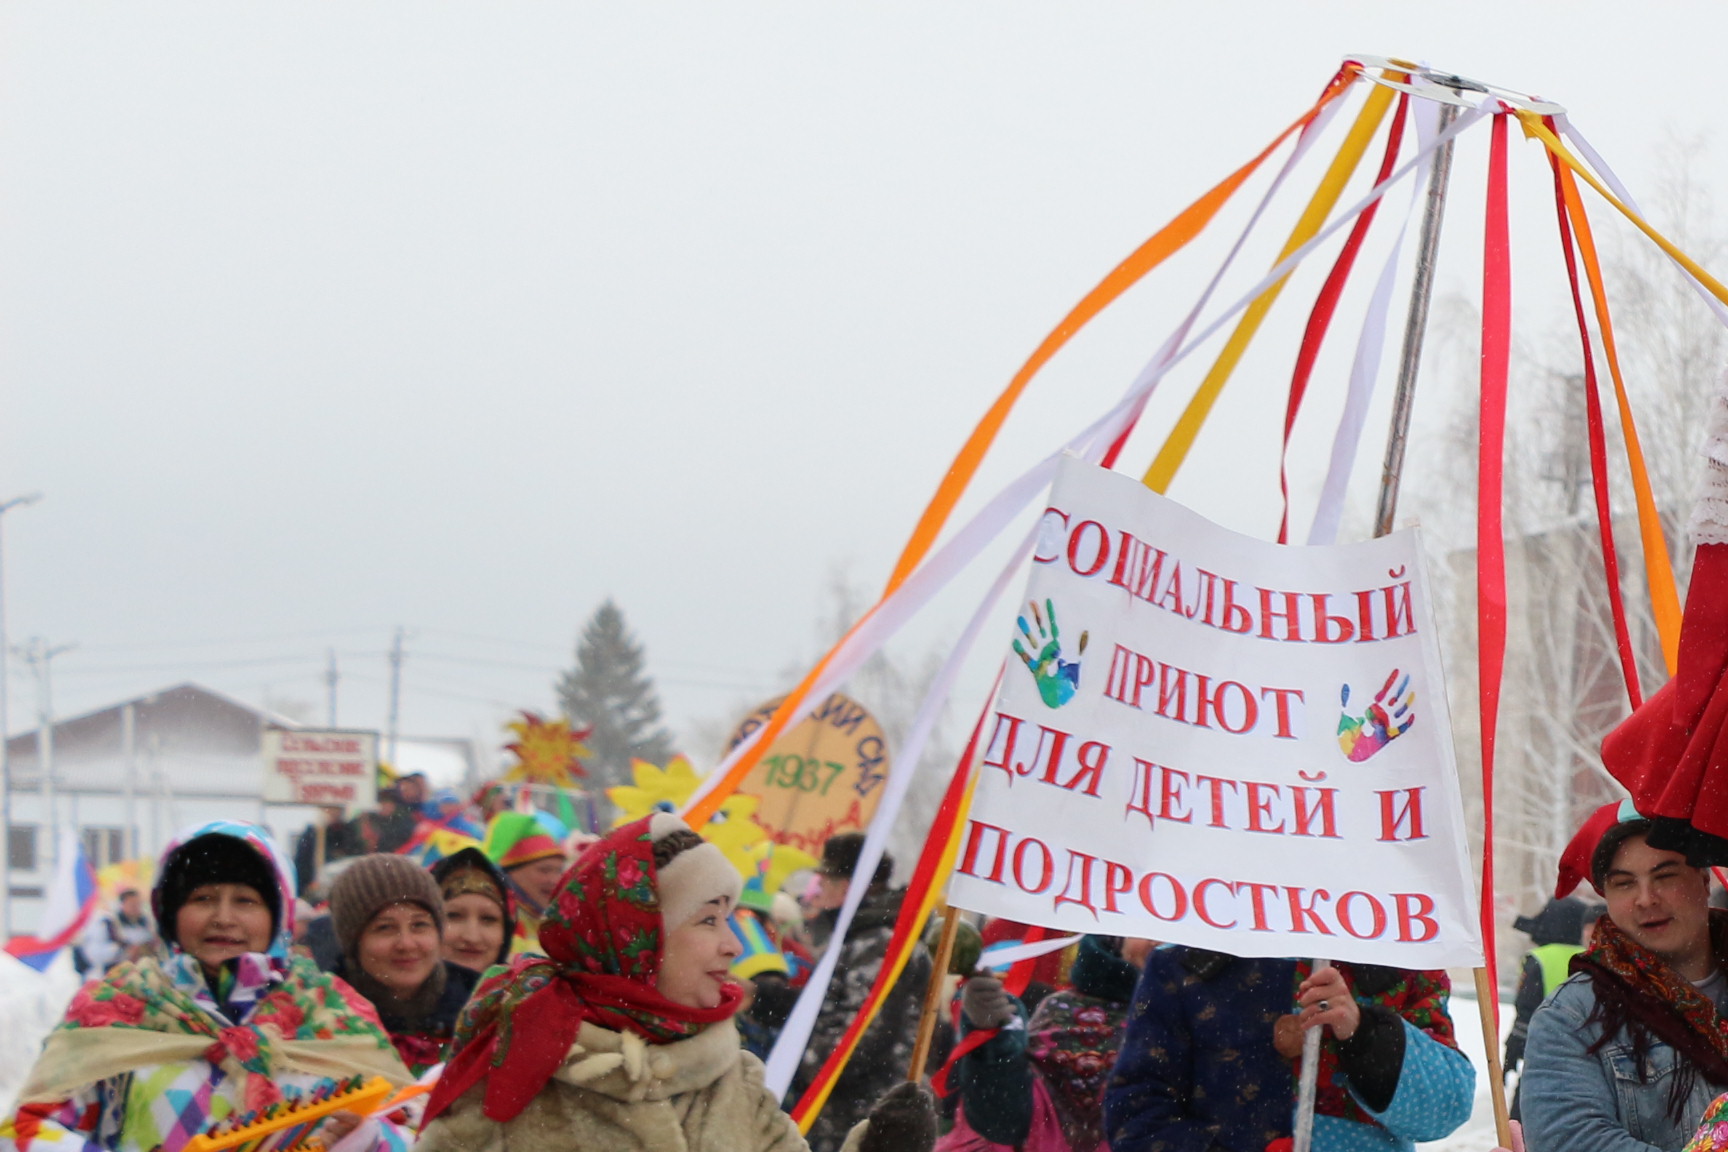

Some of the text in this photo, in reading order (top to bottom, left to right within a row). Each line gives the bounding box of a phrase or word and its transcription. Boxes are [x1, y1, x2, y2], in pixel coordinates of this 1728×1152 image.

[1034, 507, 1417, 643] СОЦИАЛЬНЫЙ
[1105, 643, 1304, 738] ПРИЮТ
[763, 755, 844, 796] 1937
[984, 713, 1429, 842] ДЛЯ ДЕТЕЙ И
[956, 820, 1440, 943] ПОДРОСТКОВ
